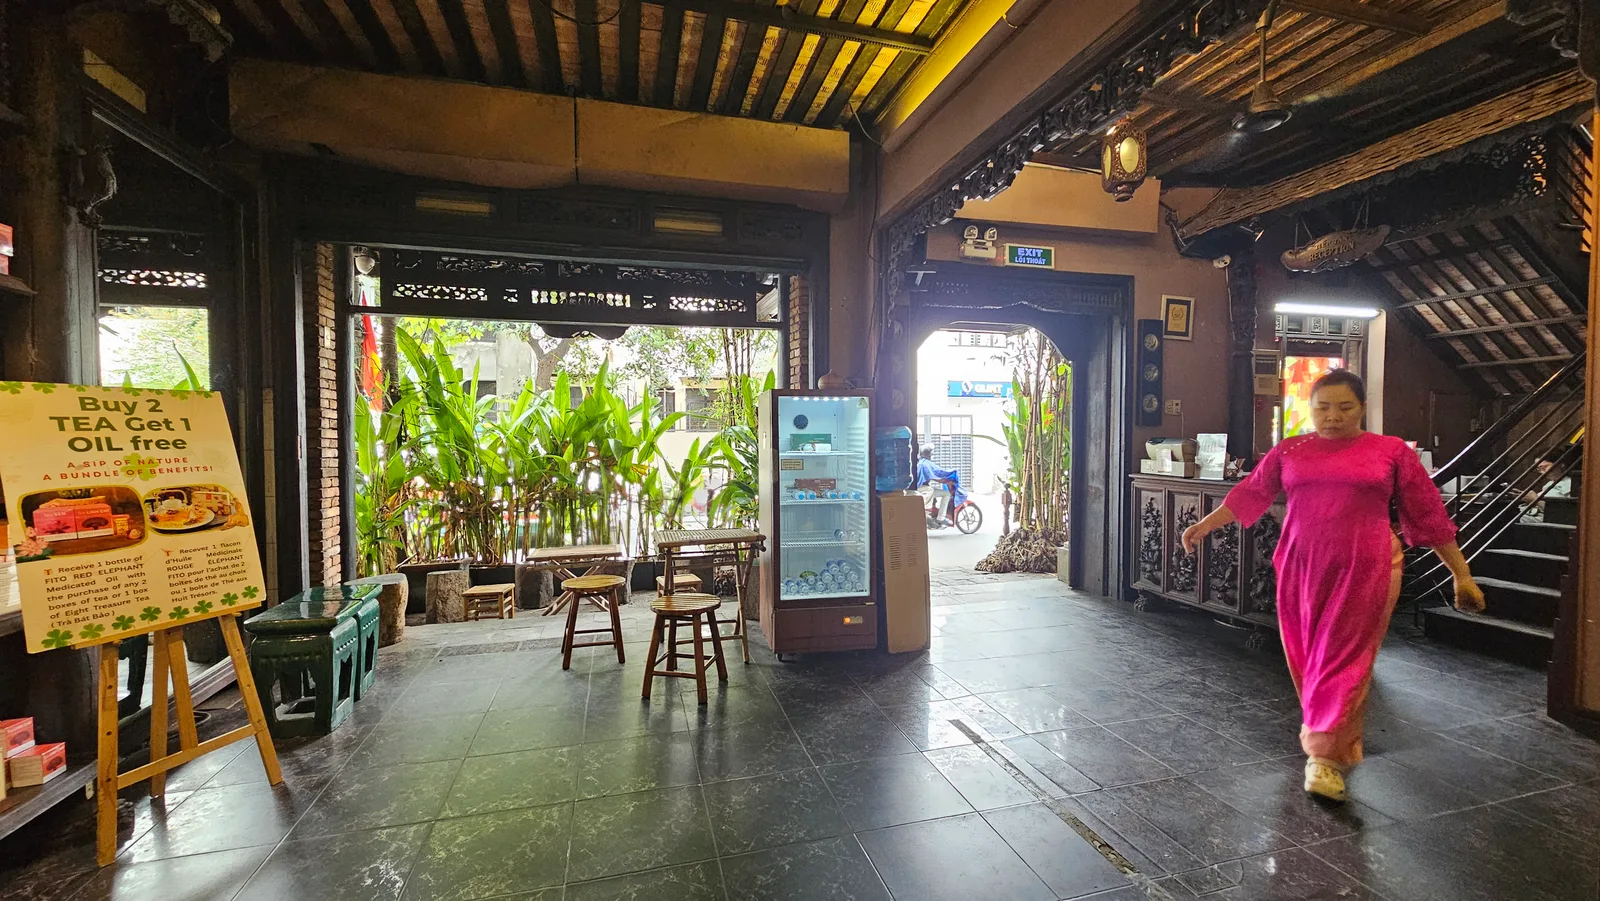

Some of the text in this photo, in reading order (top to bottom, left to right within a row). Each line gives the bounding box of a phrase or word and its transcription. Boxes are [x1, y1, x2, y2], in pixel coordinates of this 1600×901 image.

[1018, 248, 1043, 257] EXIT
[1309, 241, 1355, 262] RECEPTION
[1026, 257, 1046, 265] THOÁT
[78, 396, 163, 415] Buy 2
[49, 416, 192, 432] TEA Get 1
[67, 435, 187, 452] OIL free
[113, 459, 130, 467] OF
[138, 457, 188, 465] NATURE
[60, 470, 119, 480] BUNDLE
[150, 465, 213, 475] BENEFITS!
[165, 548, 243, 565] d'Huile Médicinale
[179, 546, 209, 554] Recevez
[58, 563, 95, 573] Receive
[105, 557, 132, 566] bottle
[166, 555, 243, 572] ROUGE ÉLÉPHANT
[45, 564, 144, 584] FITO RED ELEPHANT
[168, 572, 185, 580] FITO
[187, 569, 205, 577] pour
[206, 565, 229, 573] l'achat
[46, 580, 96, 593] Medicated
[127, 571, 146, 579] with
[47, 594, 64, 602] the
[67, 587, 110, 600] purchase
[171, 590, 218, 603] Huit Trésors.
[48, 602, 77, 611] boxes
[50, 612, 60, 620] of
[65, 607, 89, 617] Eight
[93, 599, 131, 611] Treasure
